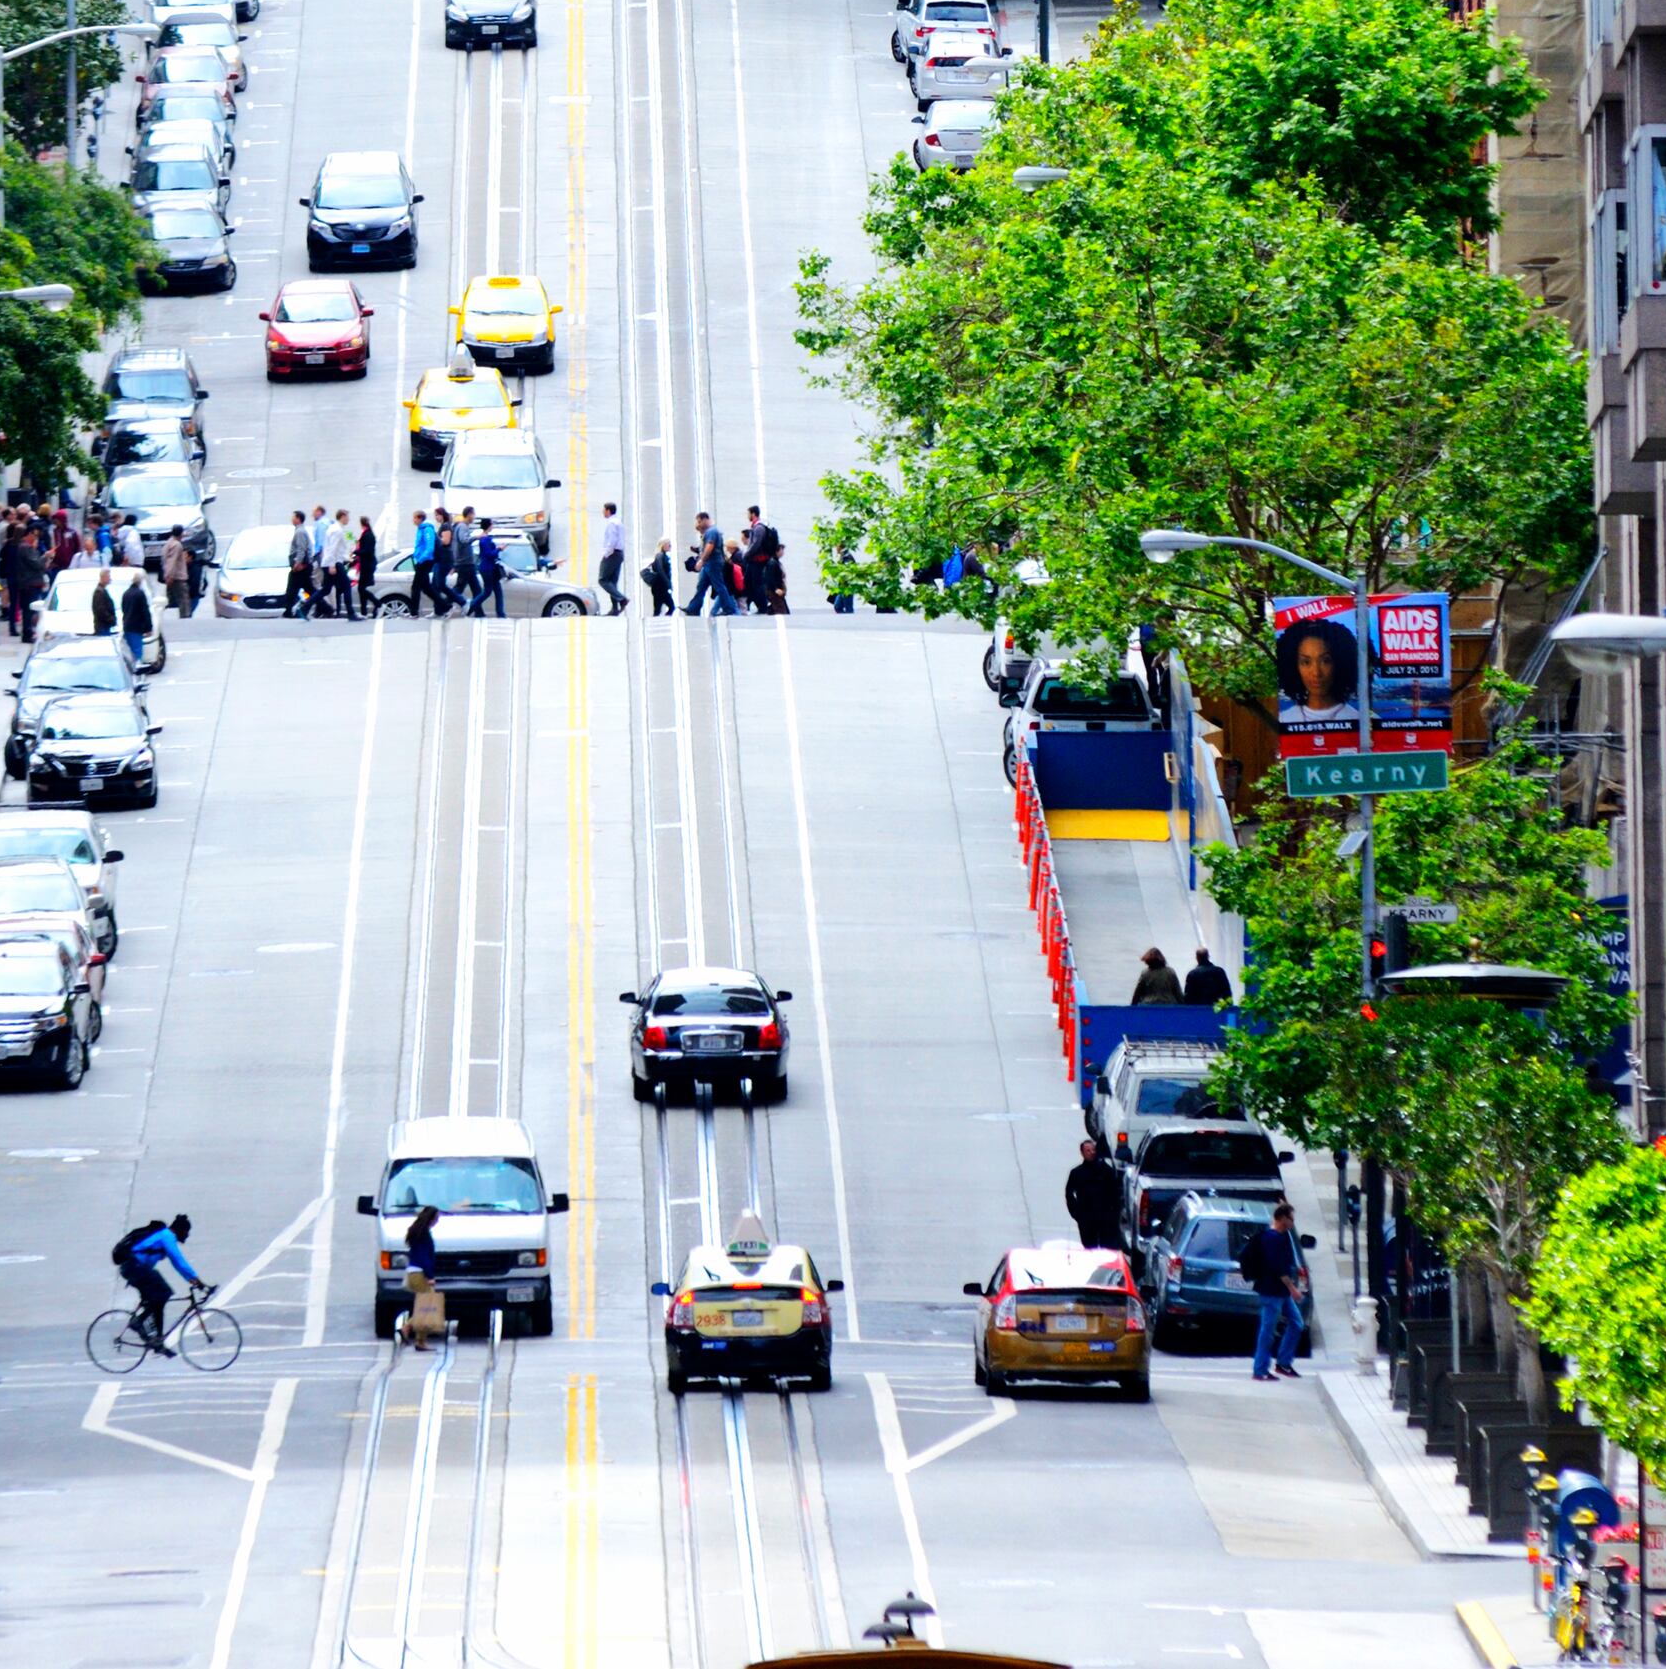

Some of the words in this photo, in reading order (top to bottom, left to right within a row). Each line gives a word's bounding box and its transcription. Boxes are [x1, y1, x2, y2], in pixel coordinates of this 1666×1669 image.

[1286, 611, 1293, 622] I
[1383, 610, 1438, 631] AIDS
[1385, 633, 1438, 650] WALK
[1384, 652, 1400, 661] SAN
[1401, 652, 1439, 661] FRANCISCO
[1386, 666, 1406, 675] JULY
[1306, 764, 1426, 786] Kearny
[1389, 908, 1447, 920] KEARNY
